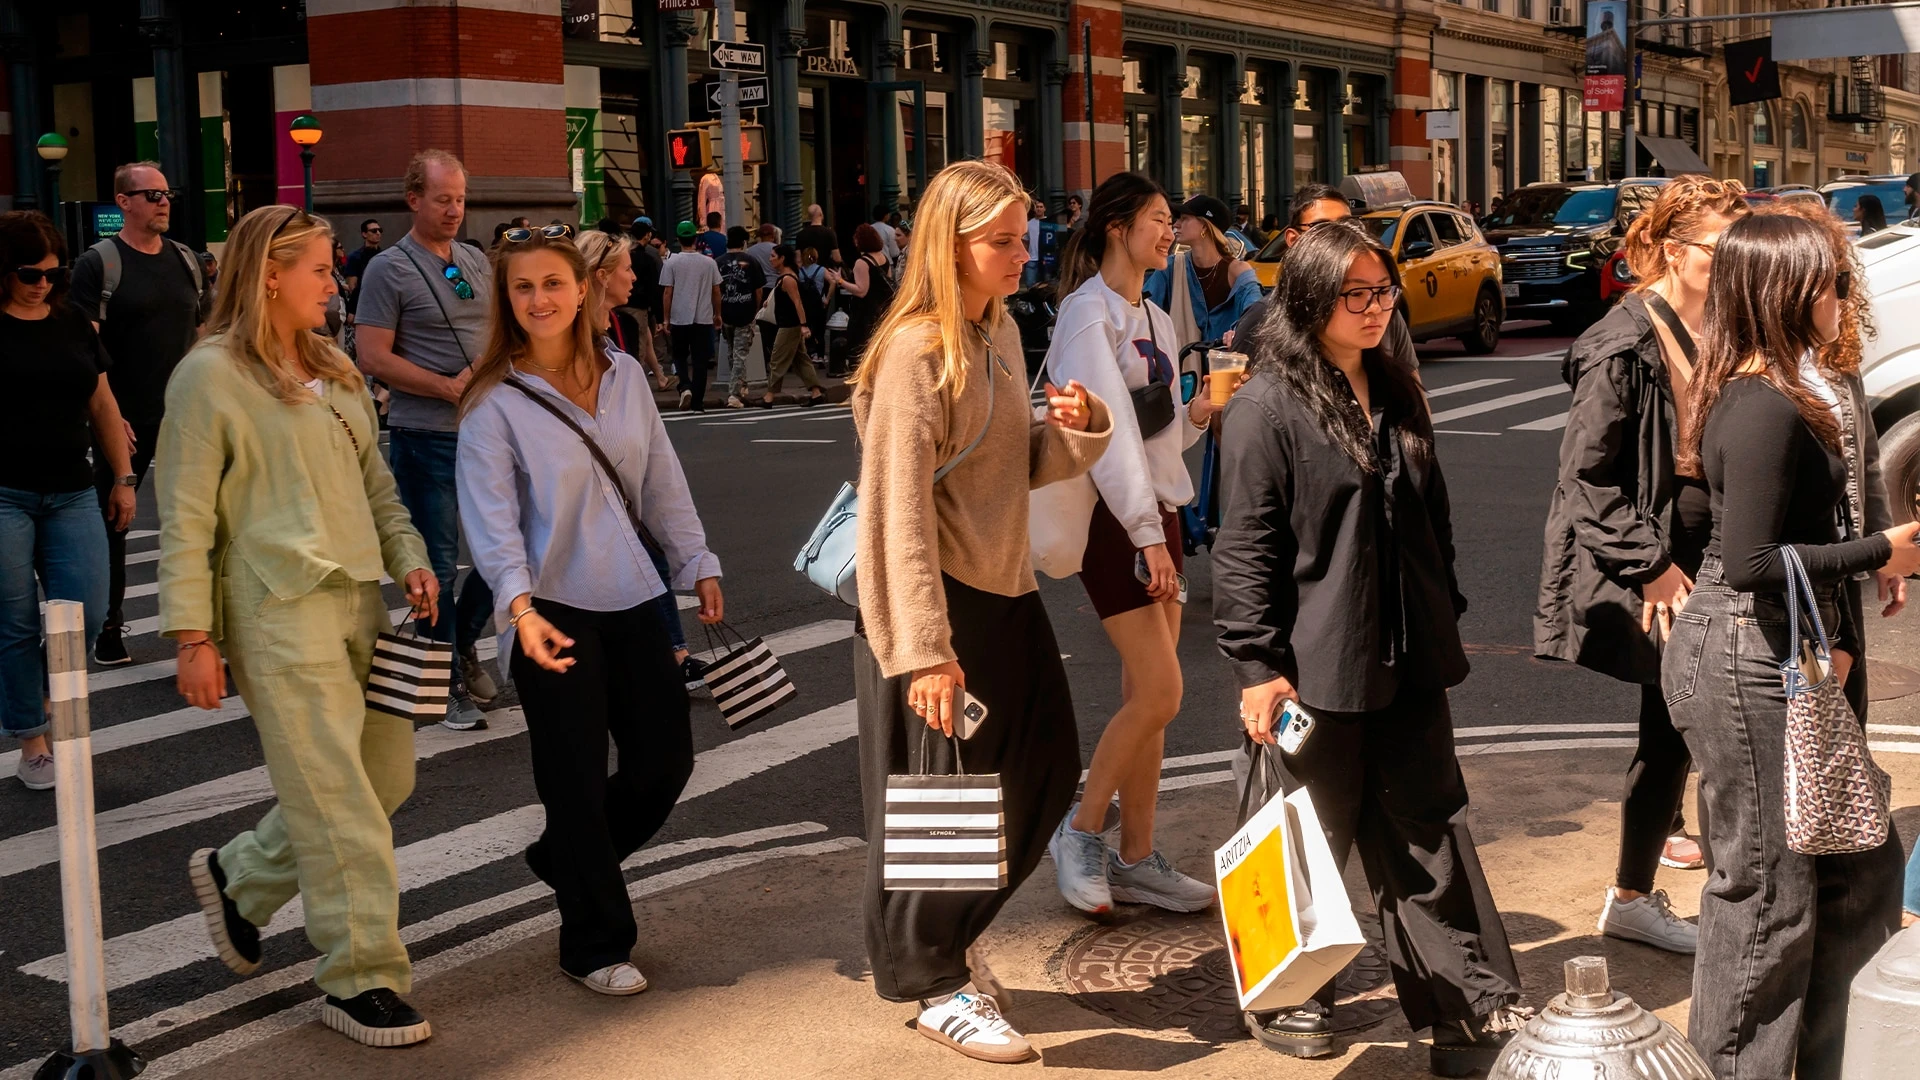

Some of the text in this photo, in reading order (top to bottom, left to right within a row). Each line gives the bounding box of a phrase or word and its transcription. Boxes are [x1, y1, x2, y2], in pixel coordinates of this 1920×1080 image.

[660, 0, 687, 8] Prince
[718, 51, 758, 64] ONE WAY
[806, 55, 860, 77] PRADA
[1600, 78, 1619, 86] Spirit
[741, 87, 760, 99] WAY
[1046, 232, 1054, 244] P
[1219, 832, 1252, 874] ARITZIA
